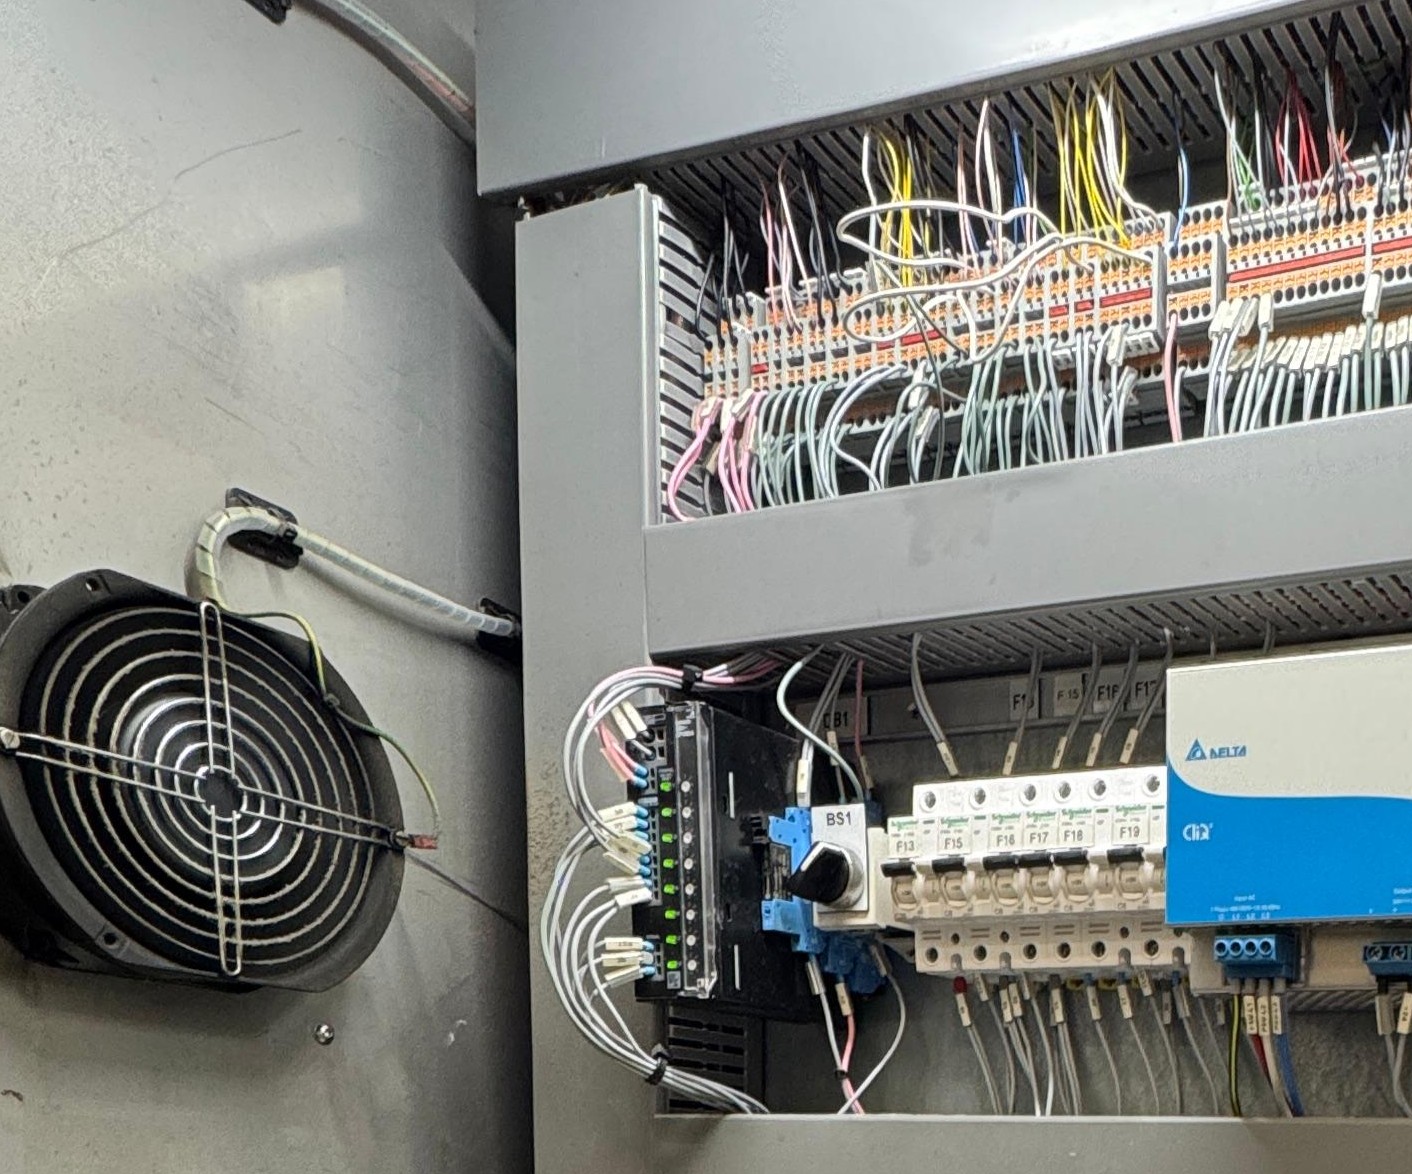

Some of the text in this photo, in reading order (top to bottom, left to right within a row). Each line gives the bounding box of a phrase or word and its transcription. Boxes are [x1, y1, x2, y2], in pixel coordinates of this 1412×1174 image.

[1209, 745, 1247, 759] DELTA
[826, 811, 852, 826] BS1
[1029, 831, 1049, 844] F17
[1119, 826, 1140, 839] F19
[896, 840, 915, 853] F13
[944, 837, 963, 850] F15
